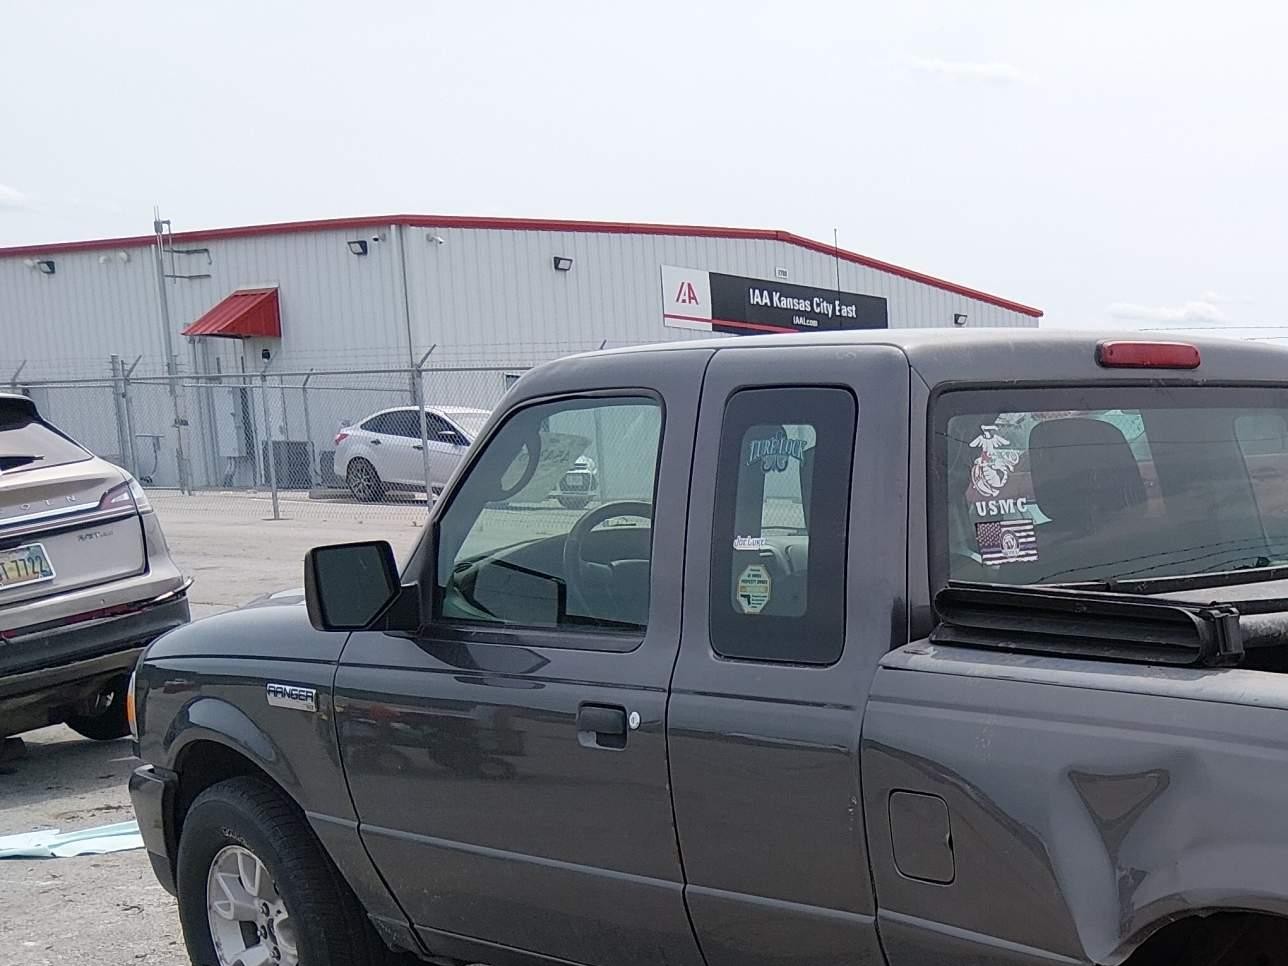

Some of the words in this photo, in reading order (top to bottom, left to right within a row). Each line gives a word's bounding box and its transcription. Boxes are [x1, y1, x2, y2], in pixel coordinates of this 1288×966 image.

[749, 288, 770, 306] IAA
[773, 292, 811, 312] Kansas
[813, 297, 833, 317] City
[835, 301, 857, 318] East
[976, 498, 1028, 516] USMC
[267, 685, 314, 702] RANGER
